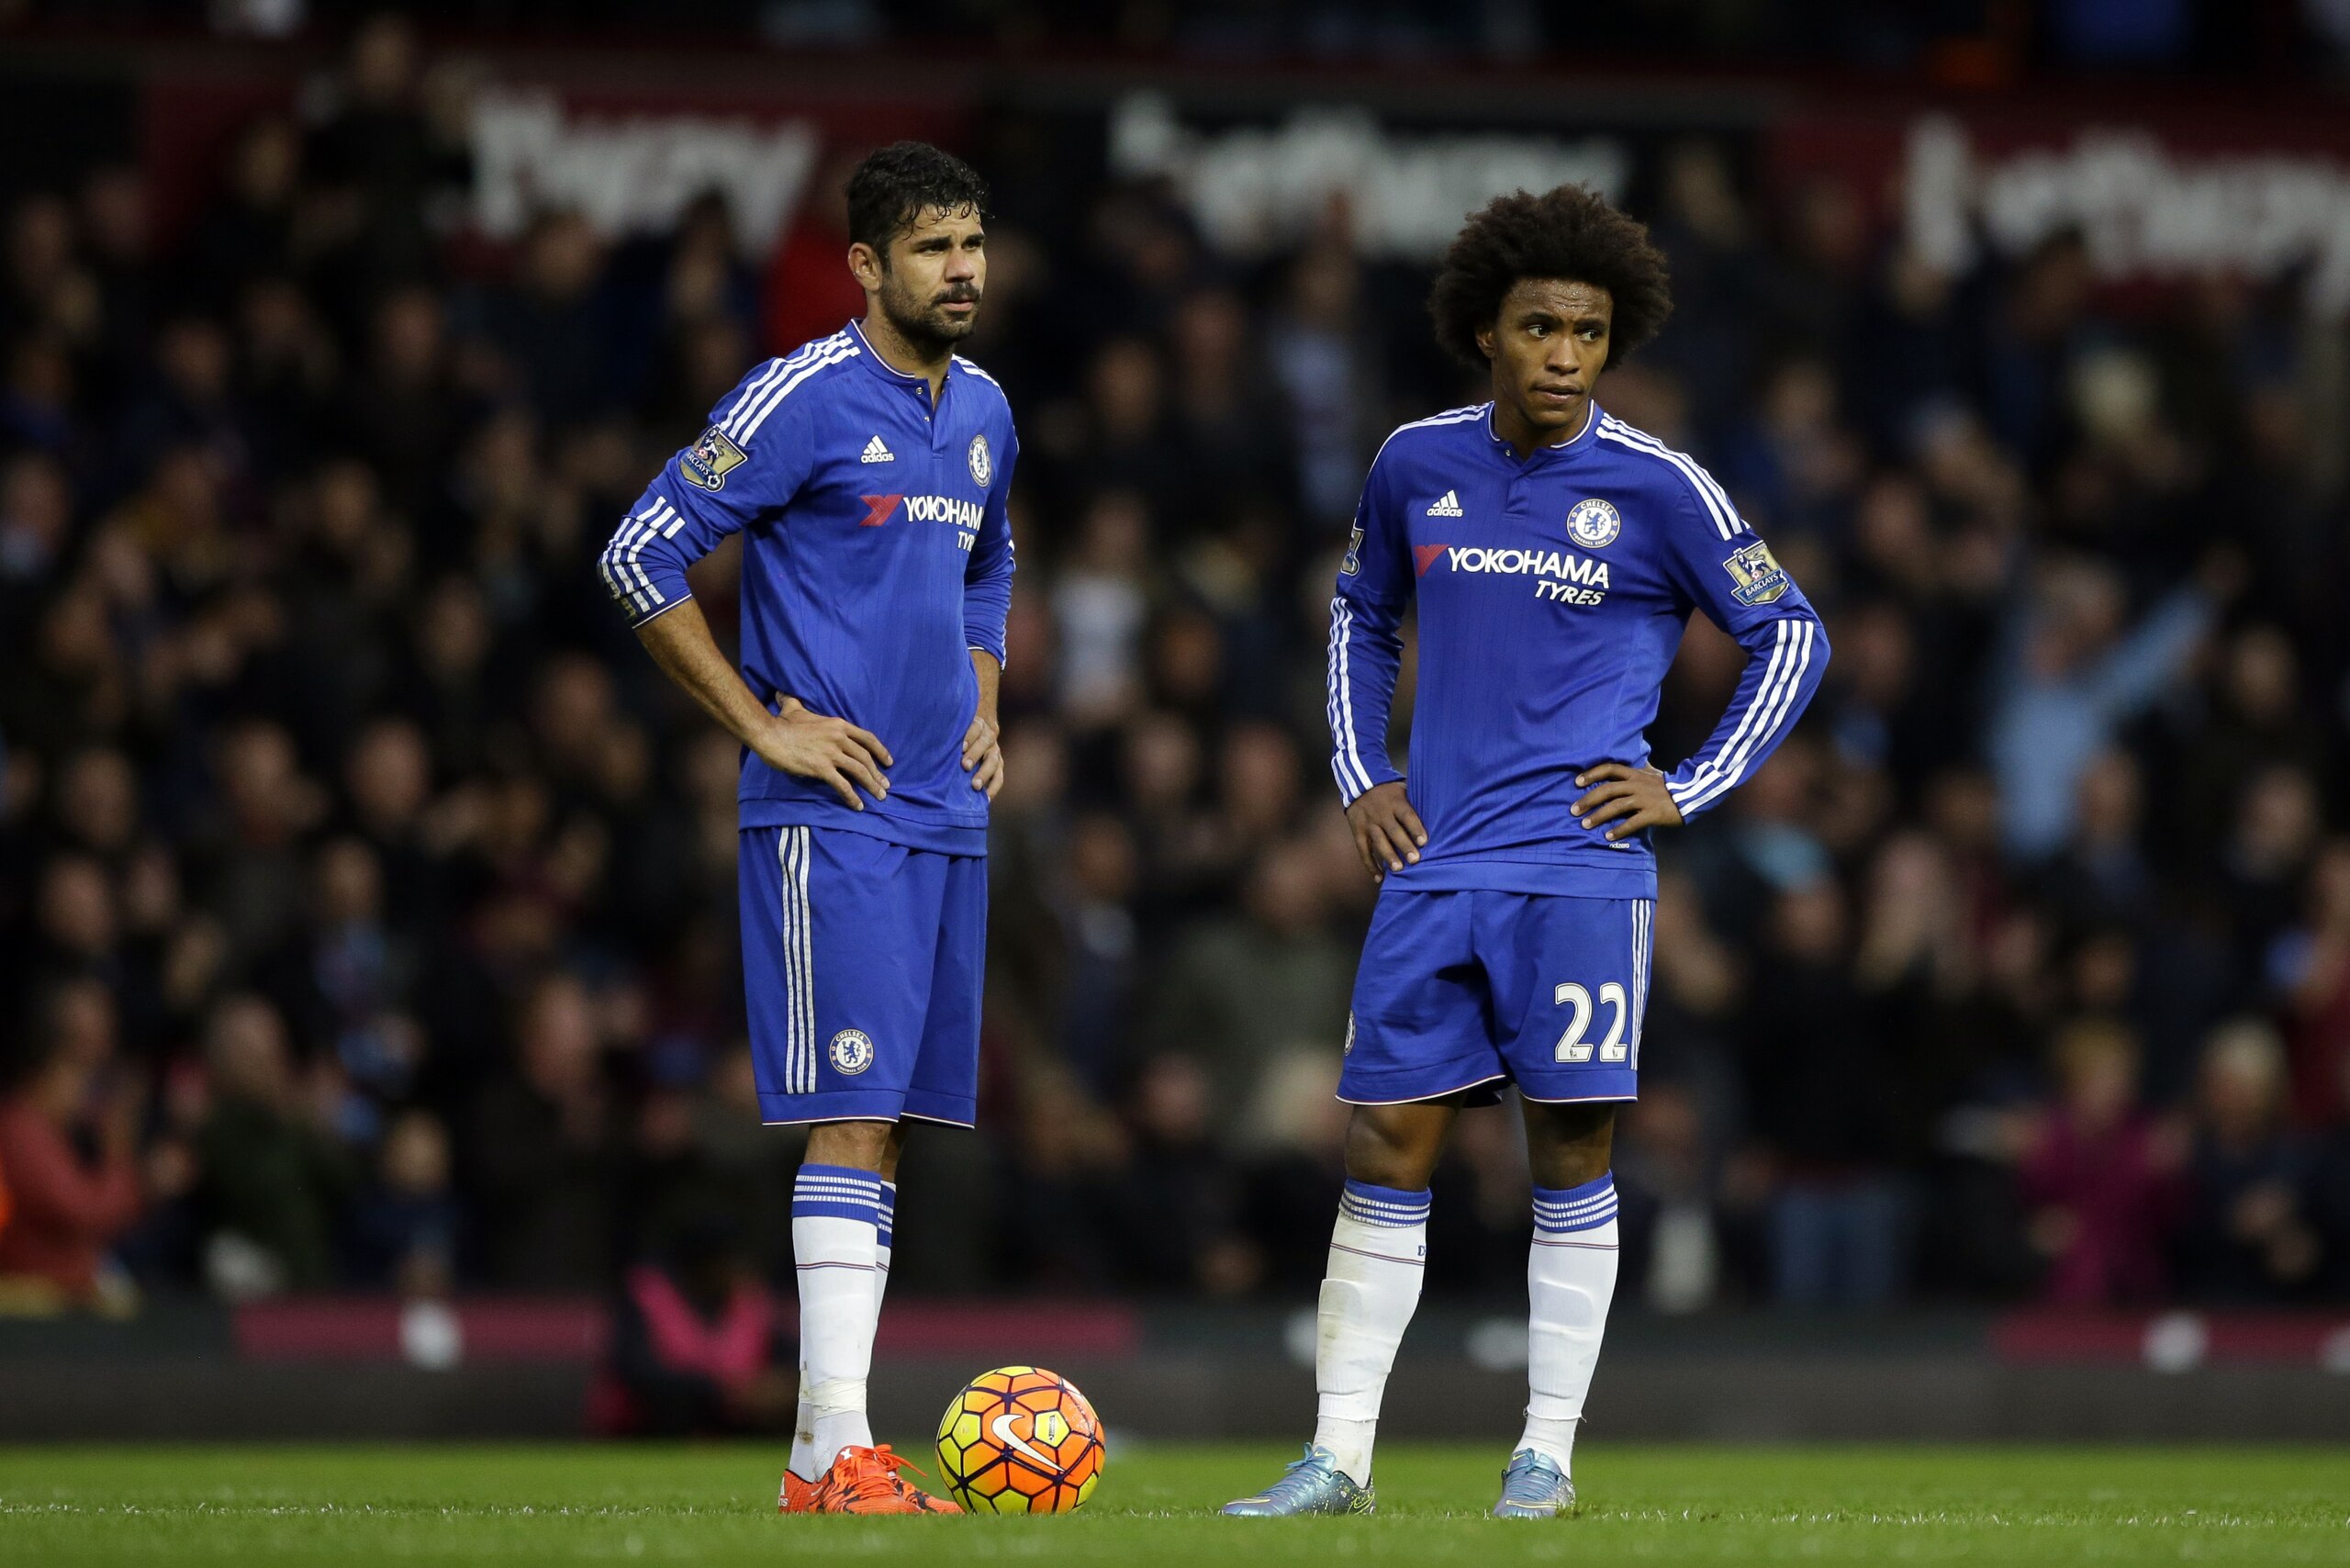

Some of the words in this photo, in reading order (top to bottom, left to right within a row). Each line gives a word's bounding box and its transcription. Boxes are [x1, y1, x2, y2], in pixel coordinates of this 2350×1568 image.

[685, 452, 711, 476] ARCLAYS
[861, 453, 895, 464] adidas
[903, 496, 984, 532] YOKOHAM
[1427, 507, 1463, 518] adidas
[1580, 500, 1614, 516] CHELSEA
[957, 531, 977, 553] TYR
[1448, 547, 1610, 588] YOKOHAMA
[1535, 580, 1606, 606] TYRES
[1745, 572, 1779, 597] BARCLAYS
[1554, 981, 1628, 1063] 22
[836, 1031, 864, 1041] CHELSEA
